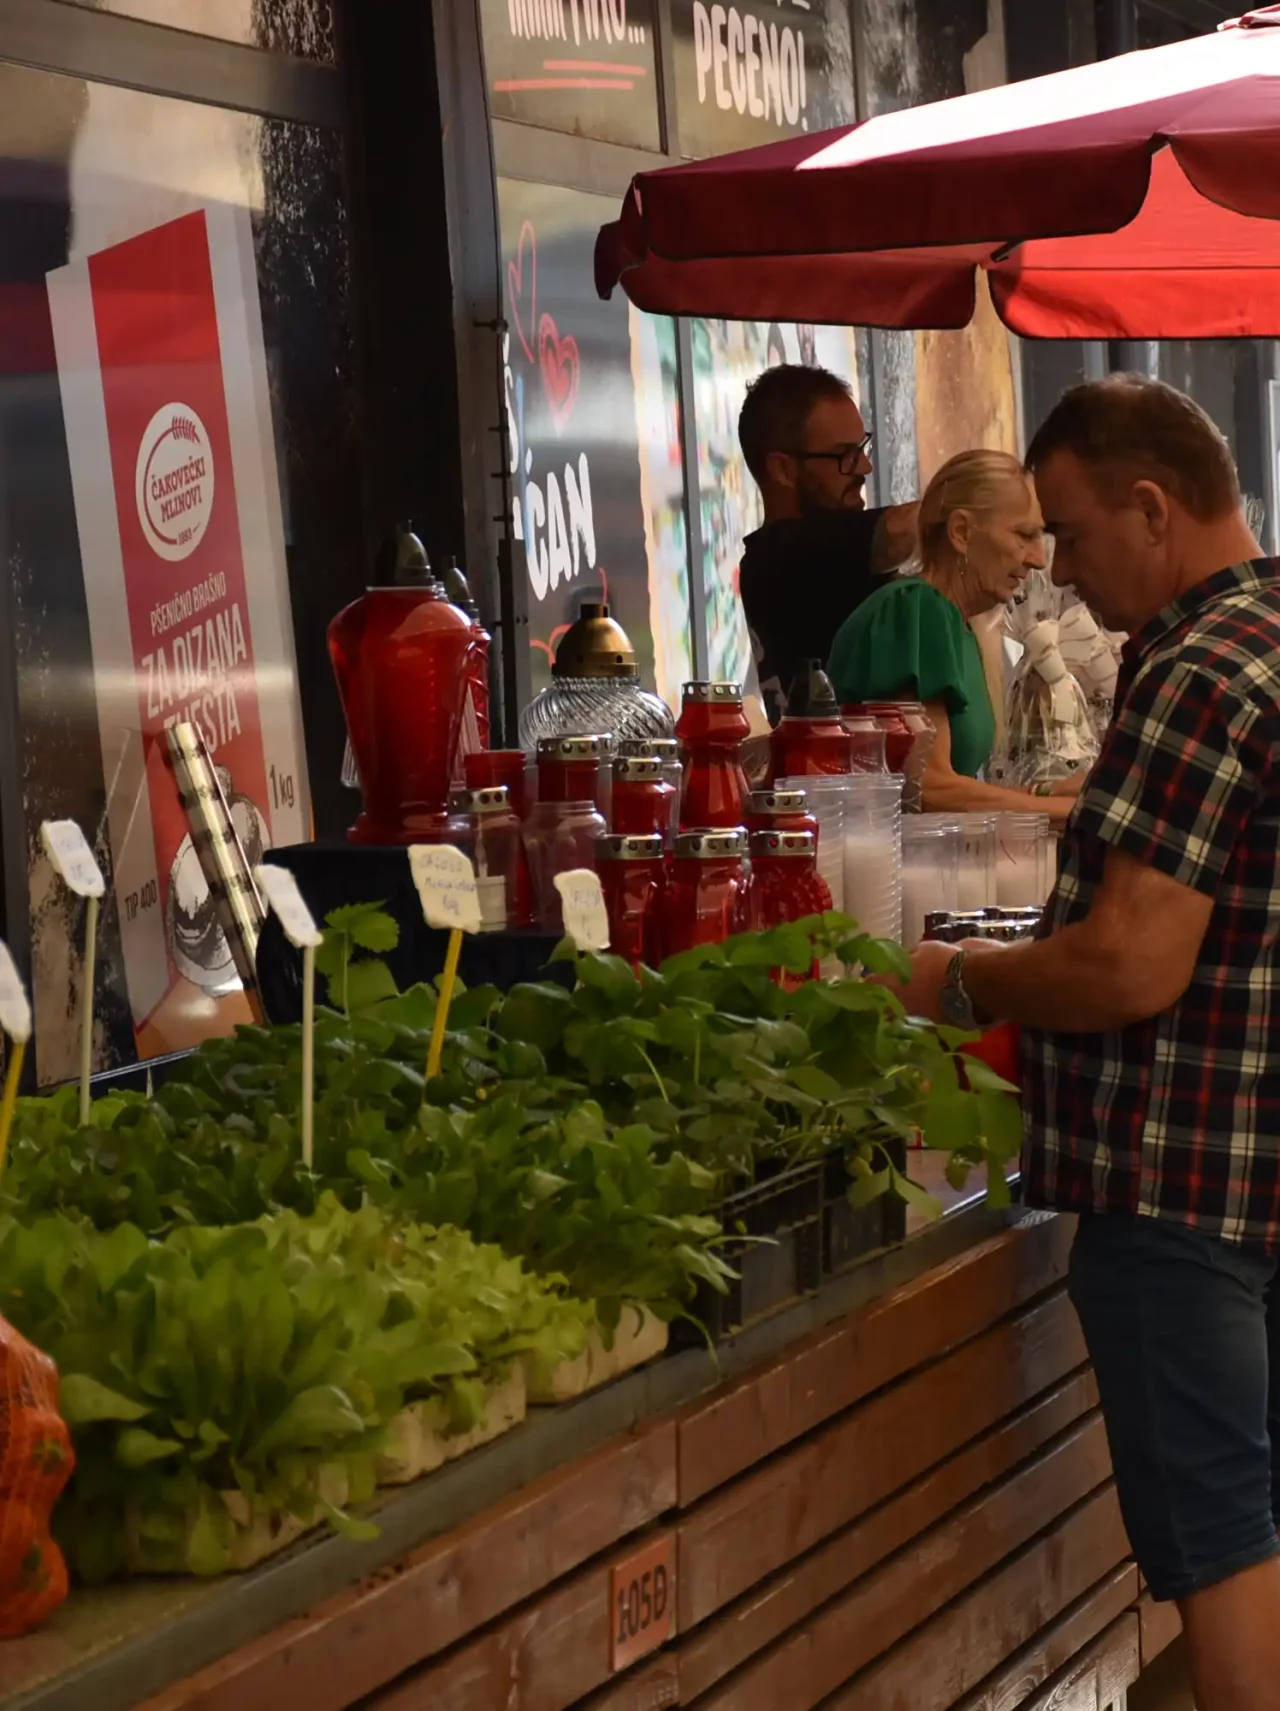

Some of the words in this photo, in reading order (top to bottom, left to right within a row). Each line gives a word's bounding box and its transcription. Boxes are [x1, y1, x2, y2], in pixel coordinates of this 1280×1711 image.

[151, 455, 206, 501] ČAKOVEČKI
[160, 484, 203, 524] MLINOVI
[150, 591, 193, 637] PŠENIČNO
[193, 571, 227, 613] BRAŠNO
[142, 647, 173, 719] ZA
[124, 891, 139, 922] TIP
[140, 879, 158, 910] 400
